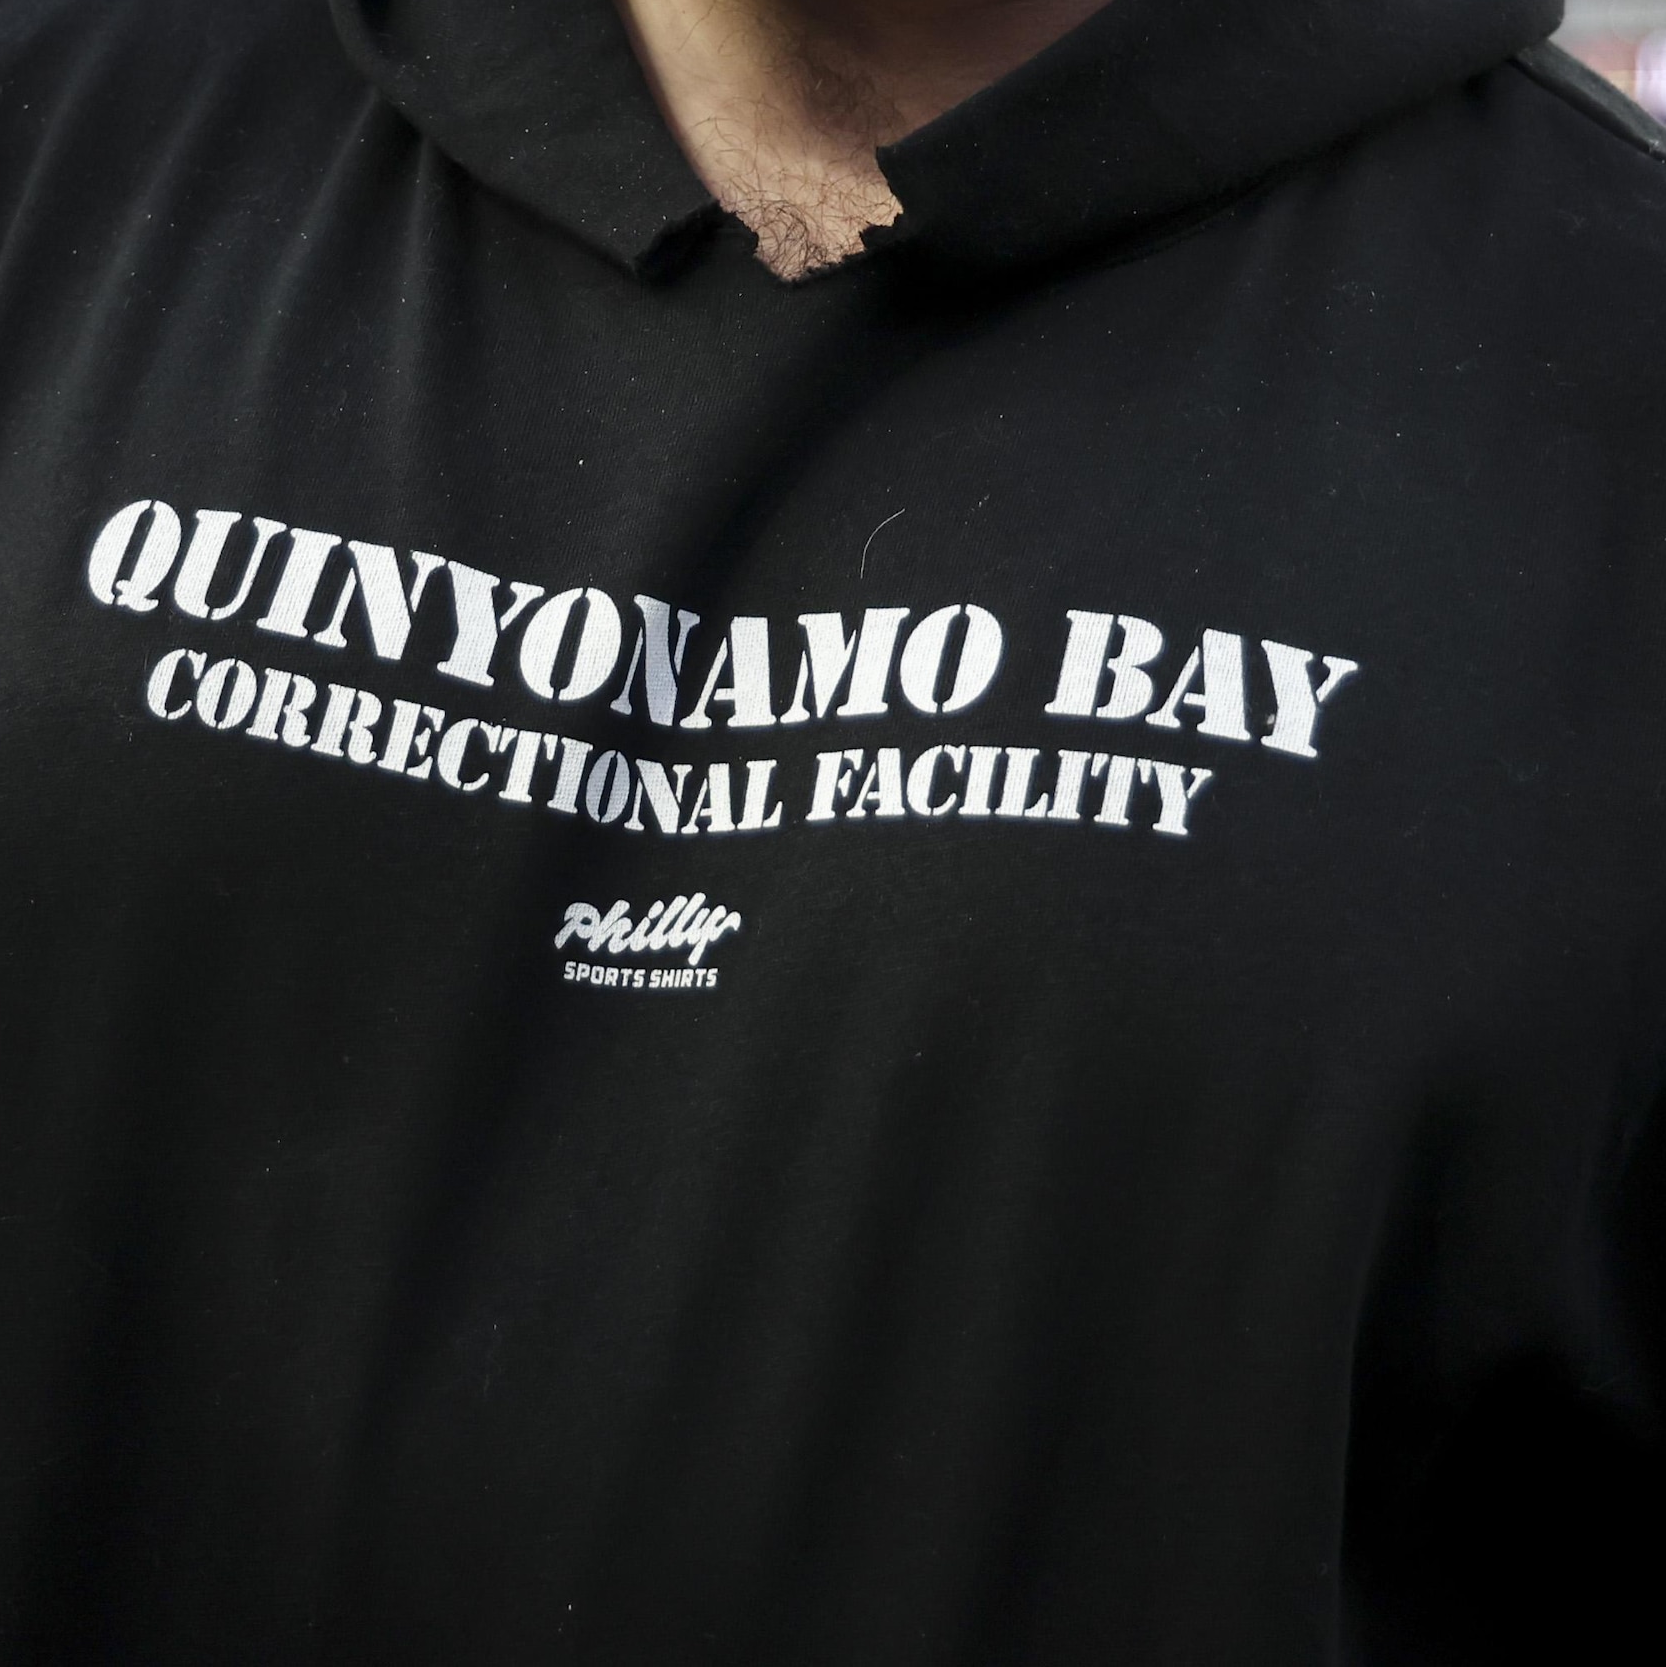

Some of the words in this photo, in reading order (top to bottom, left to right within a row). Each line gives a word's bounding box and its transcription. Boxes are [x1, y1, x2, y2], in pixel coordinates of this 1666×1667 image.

[85, 498, 1006, 732] QUINYONAMO
[1042, 608, 1360, 760] BAY
[145, 646, 785, 836] CORRECTIONAL
[803, 742, 1215, 838] FACILITY
[553, 891, 743, 967] Philly
[563, 960, 647, 989] SPORTS
[648, 967, 719, 989] SHIRTS
